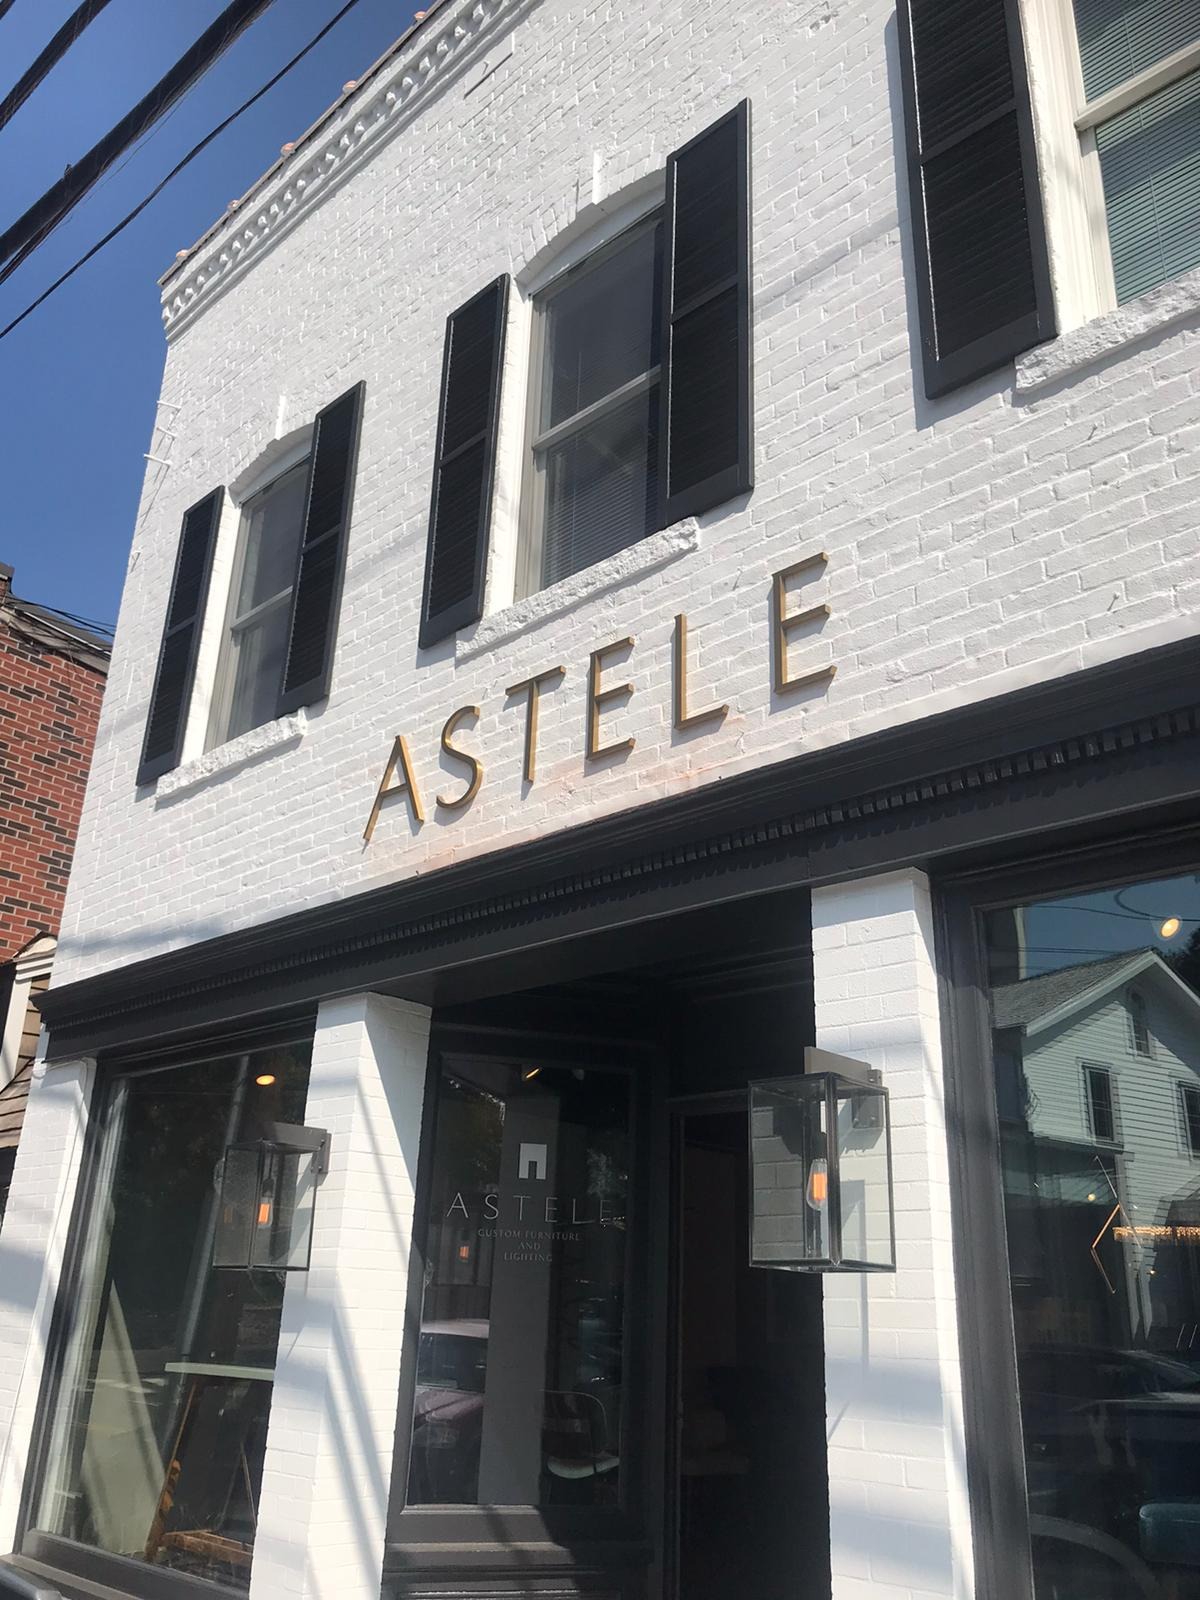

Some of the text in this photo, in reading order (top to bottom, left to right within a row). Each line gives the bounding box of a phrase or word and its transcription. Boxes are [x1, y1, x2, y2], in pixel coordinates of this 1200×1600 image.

[363, 552, 837, 841] ASTELE
[446, 1192, 613, 1225] ASTELE
[478, 1229, 580, 1241] CUSTOM FURNITURE
[519, 1242, 541, 1251] AND
[504, 1253, 553, 1262] LIGHTING
